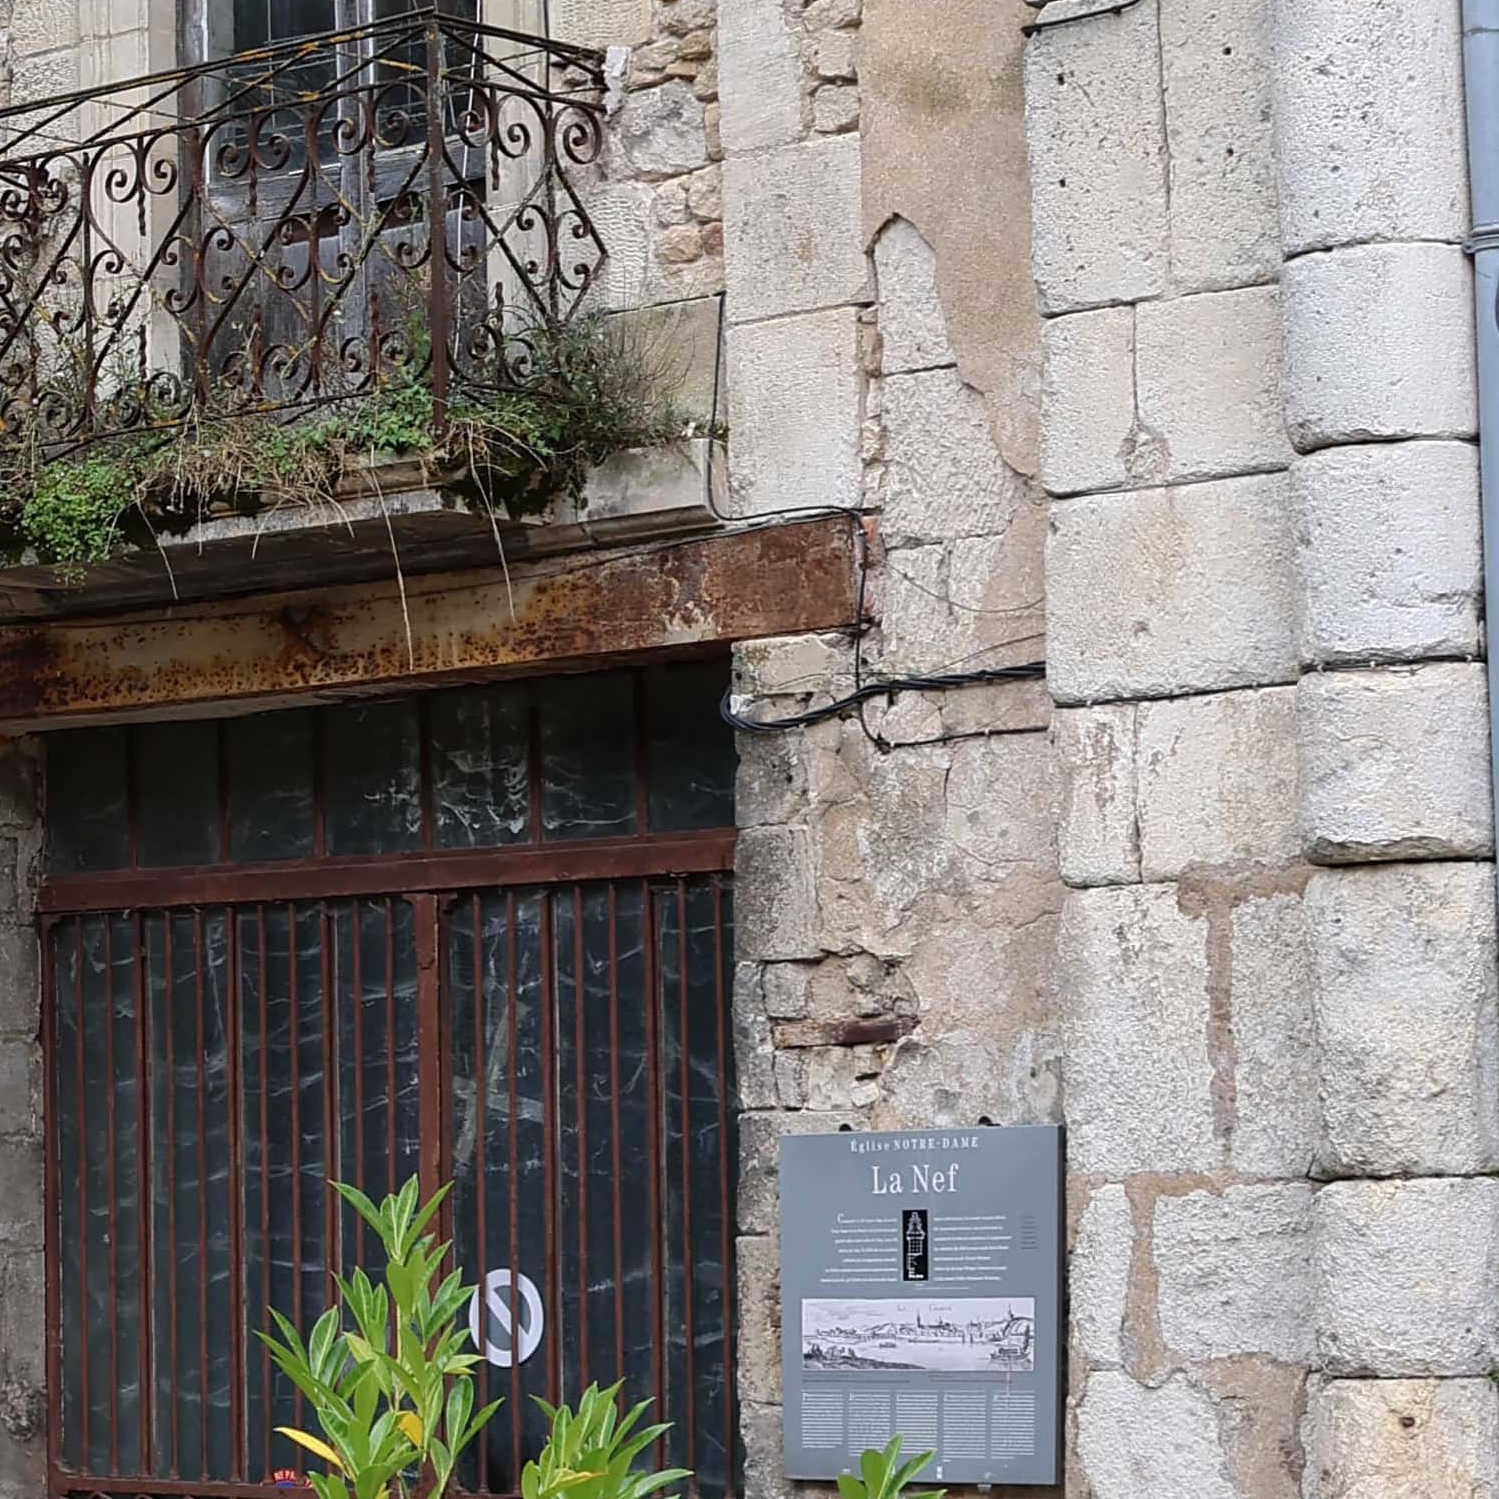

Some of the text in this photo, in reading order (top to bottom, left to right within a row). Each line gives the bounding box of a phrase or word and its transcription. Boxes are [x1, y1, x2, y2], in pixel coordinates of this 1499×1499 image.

[850, 1136, 979, 1153] Église NOTRE-DAME
[871, 1162, 959, 1194] La Nef
